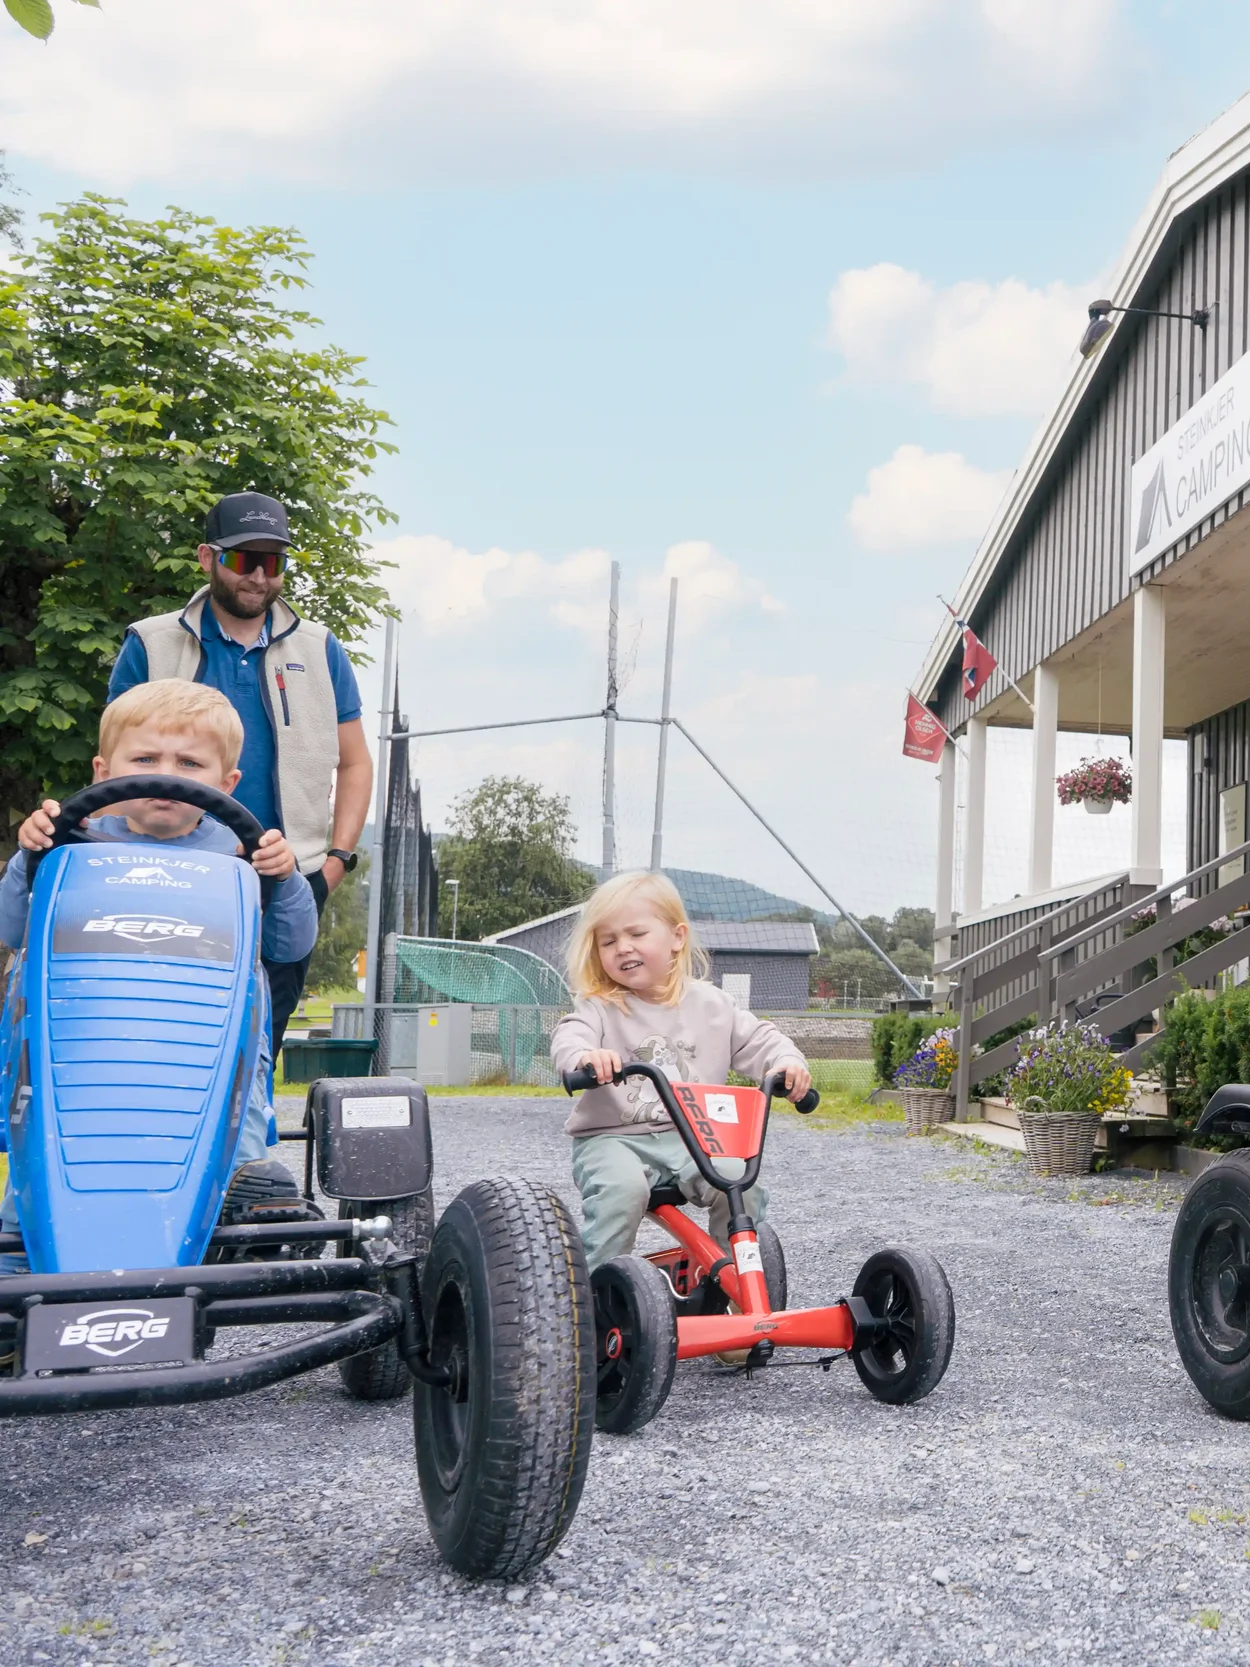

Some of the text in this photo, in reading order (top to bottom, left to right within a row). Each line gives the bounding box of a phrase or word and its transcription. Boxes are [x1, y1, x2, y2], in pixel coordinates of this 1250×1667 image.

[1177, 386, 1235, 461] STEINKJER
[87, 855, 210, 875] STEINKJER
[105, 876, 193, 889] CAMPING
[82, 919, 205, 938] BERG
[59, 1317, 171, 1346] BERG
